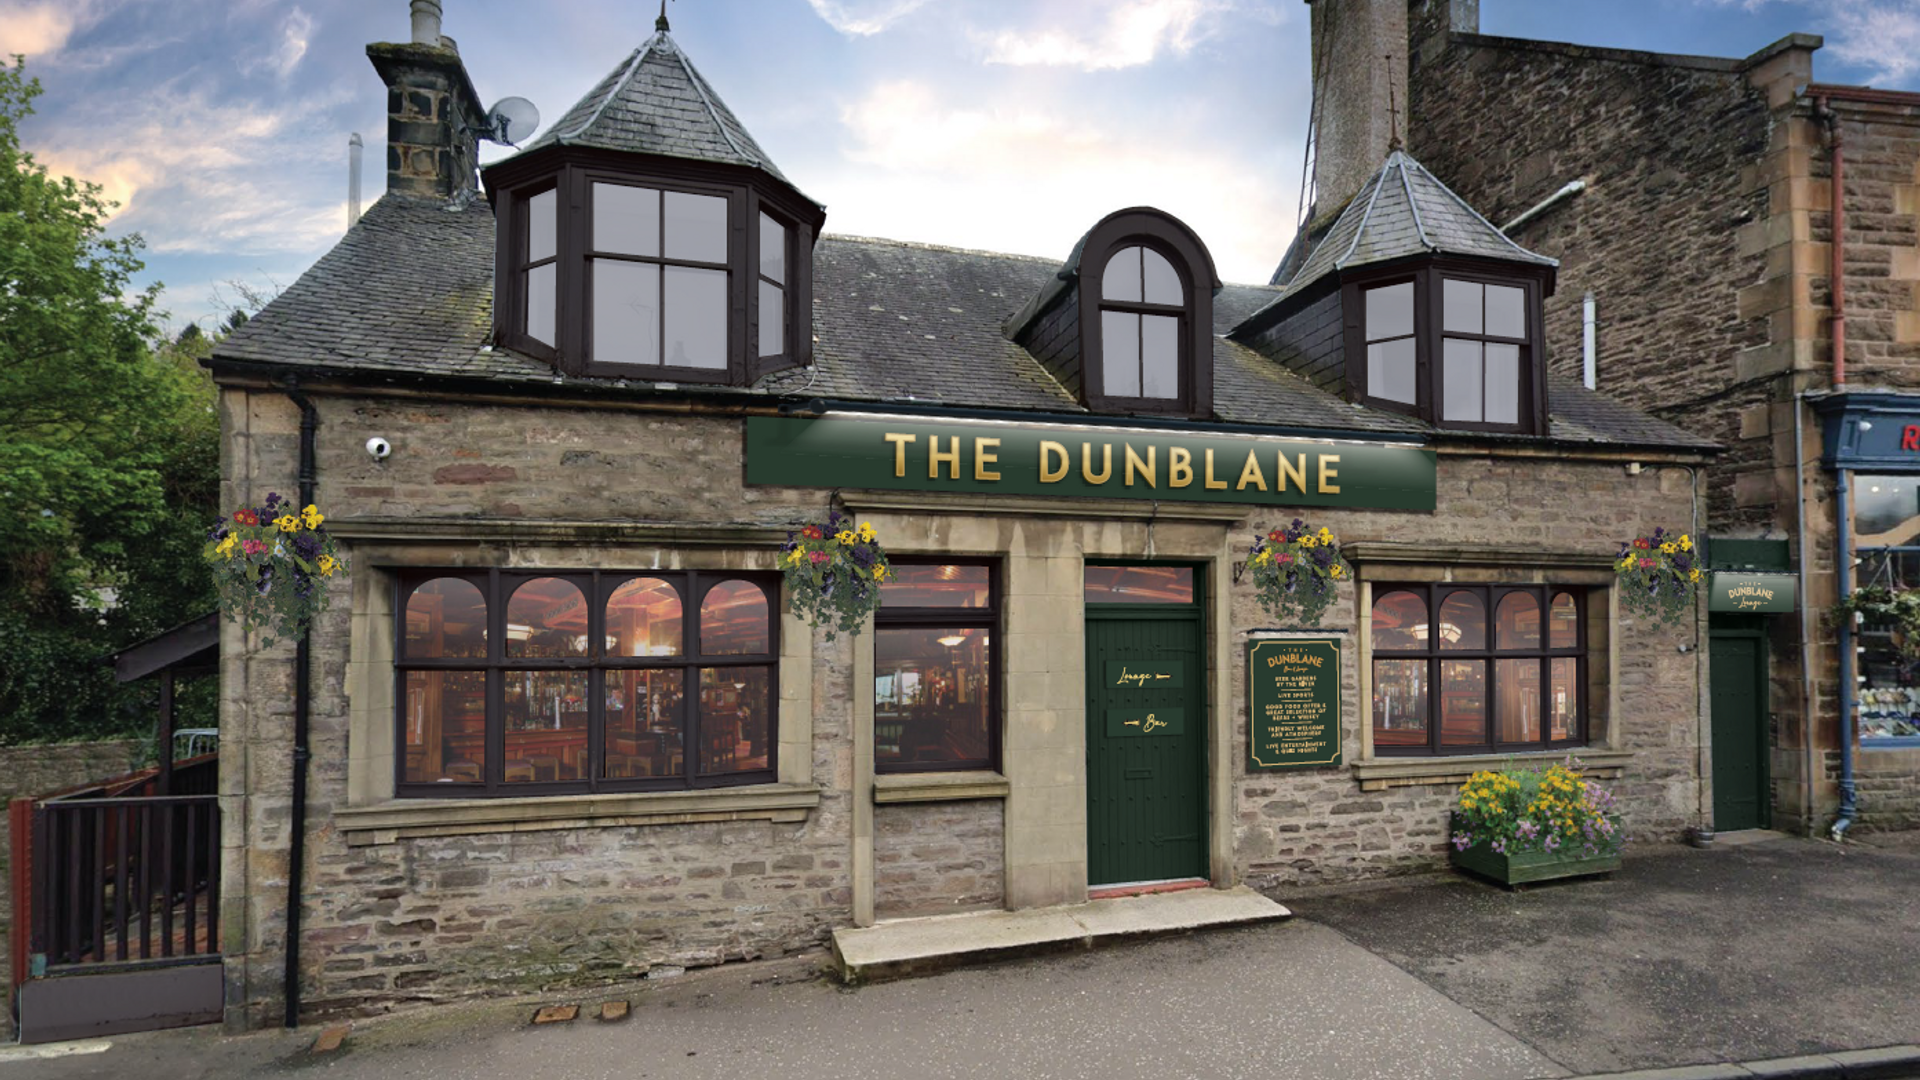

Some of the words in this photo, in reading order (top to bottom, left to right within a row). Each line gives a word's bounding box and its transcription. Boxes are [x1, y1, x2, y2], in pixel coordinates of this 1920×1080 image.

[884, 432, 1001, 480] THE
[1040, 440, 1340, 494] DUNBLANE
[1728, 587, 1774, 600] DUNBLANE
[1267, 653, 1324, 668] DUNBLANE
[1116, 666, 1152, 687] Lounge
[1143, 714, 1168, 733] Bar
